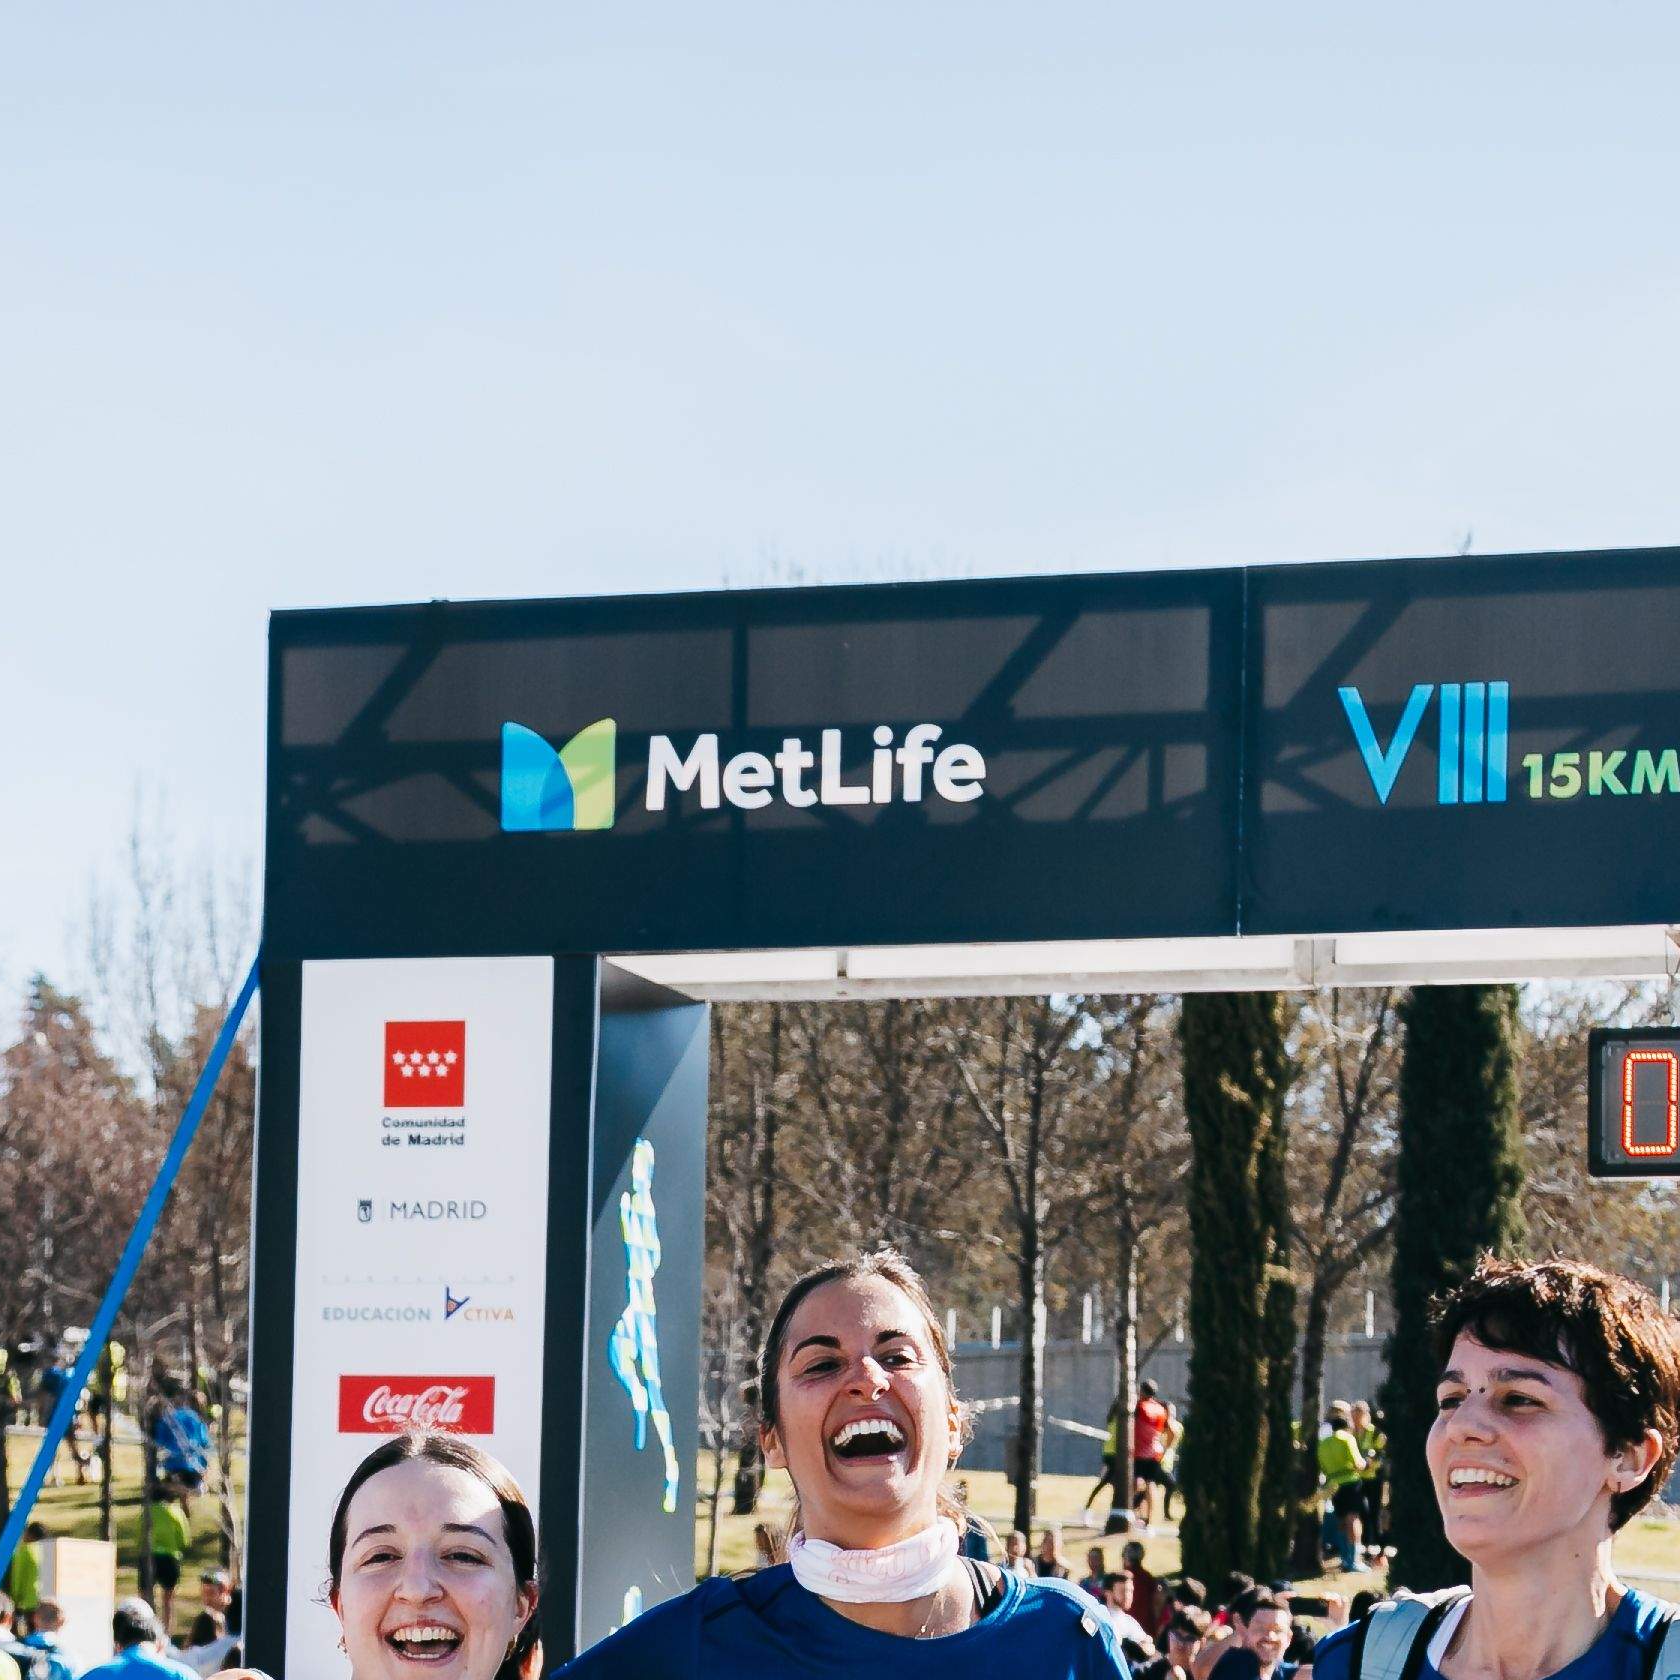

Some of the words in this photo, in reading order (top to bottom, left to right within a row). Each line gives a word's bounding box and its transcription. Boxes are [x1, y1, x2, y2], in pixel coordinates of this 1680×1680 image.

[1337, 680, 1509, 805] VIII
[645, 723, 987, 811] MetLife
[381, 1116, 466, 1129] Comunidad
[381, 1134, 401, 1146] de
[407, 1133, 465, 1146] Madrid
[390, 1200, 488, 1220] MADRID
[322, 1302, 432, 1322] EDUCACIÓN
